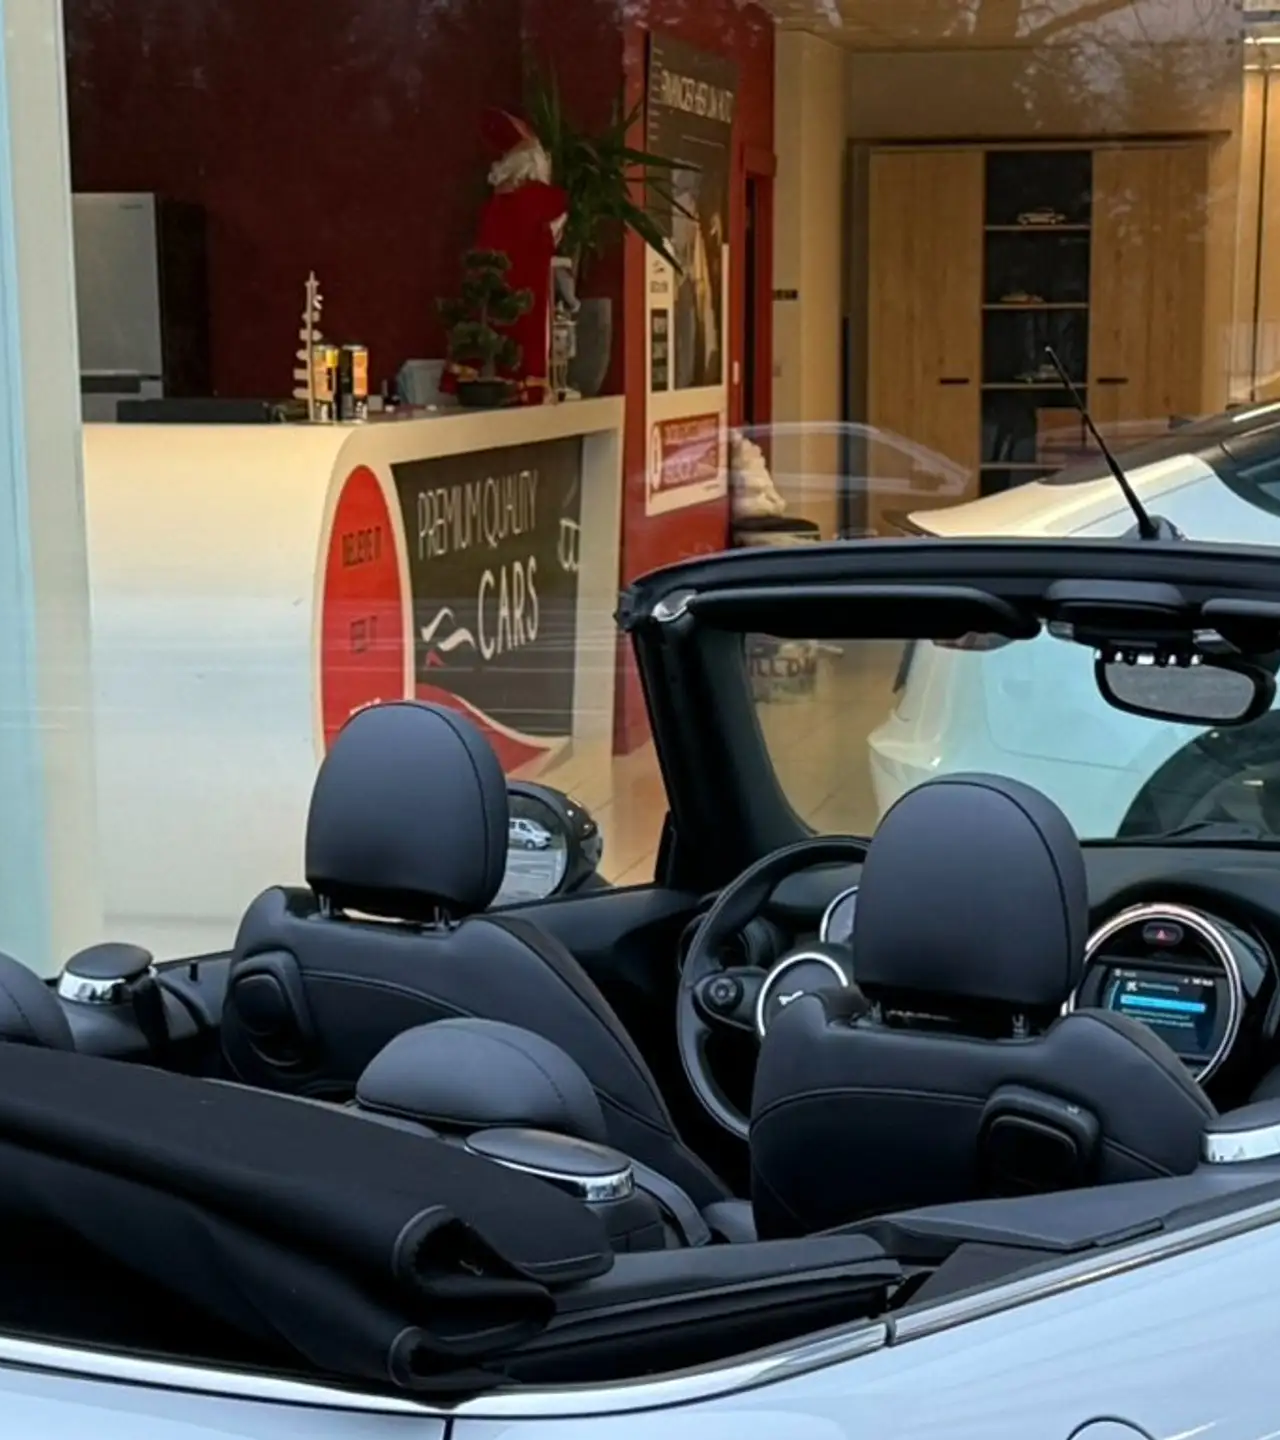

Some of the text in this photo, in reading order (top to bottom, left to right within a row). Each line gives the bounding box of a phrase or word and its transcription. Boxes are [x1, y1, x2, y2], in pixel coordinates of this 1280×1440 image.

[418, 483, 481, 560] PREMIUM
[483, 470, 538, 548] QUALITY
[478, 555, 539, 660] CARS
